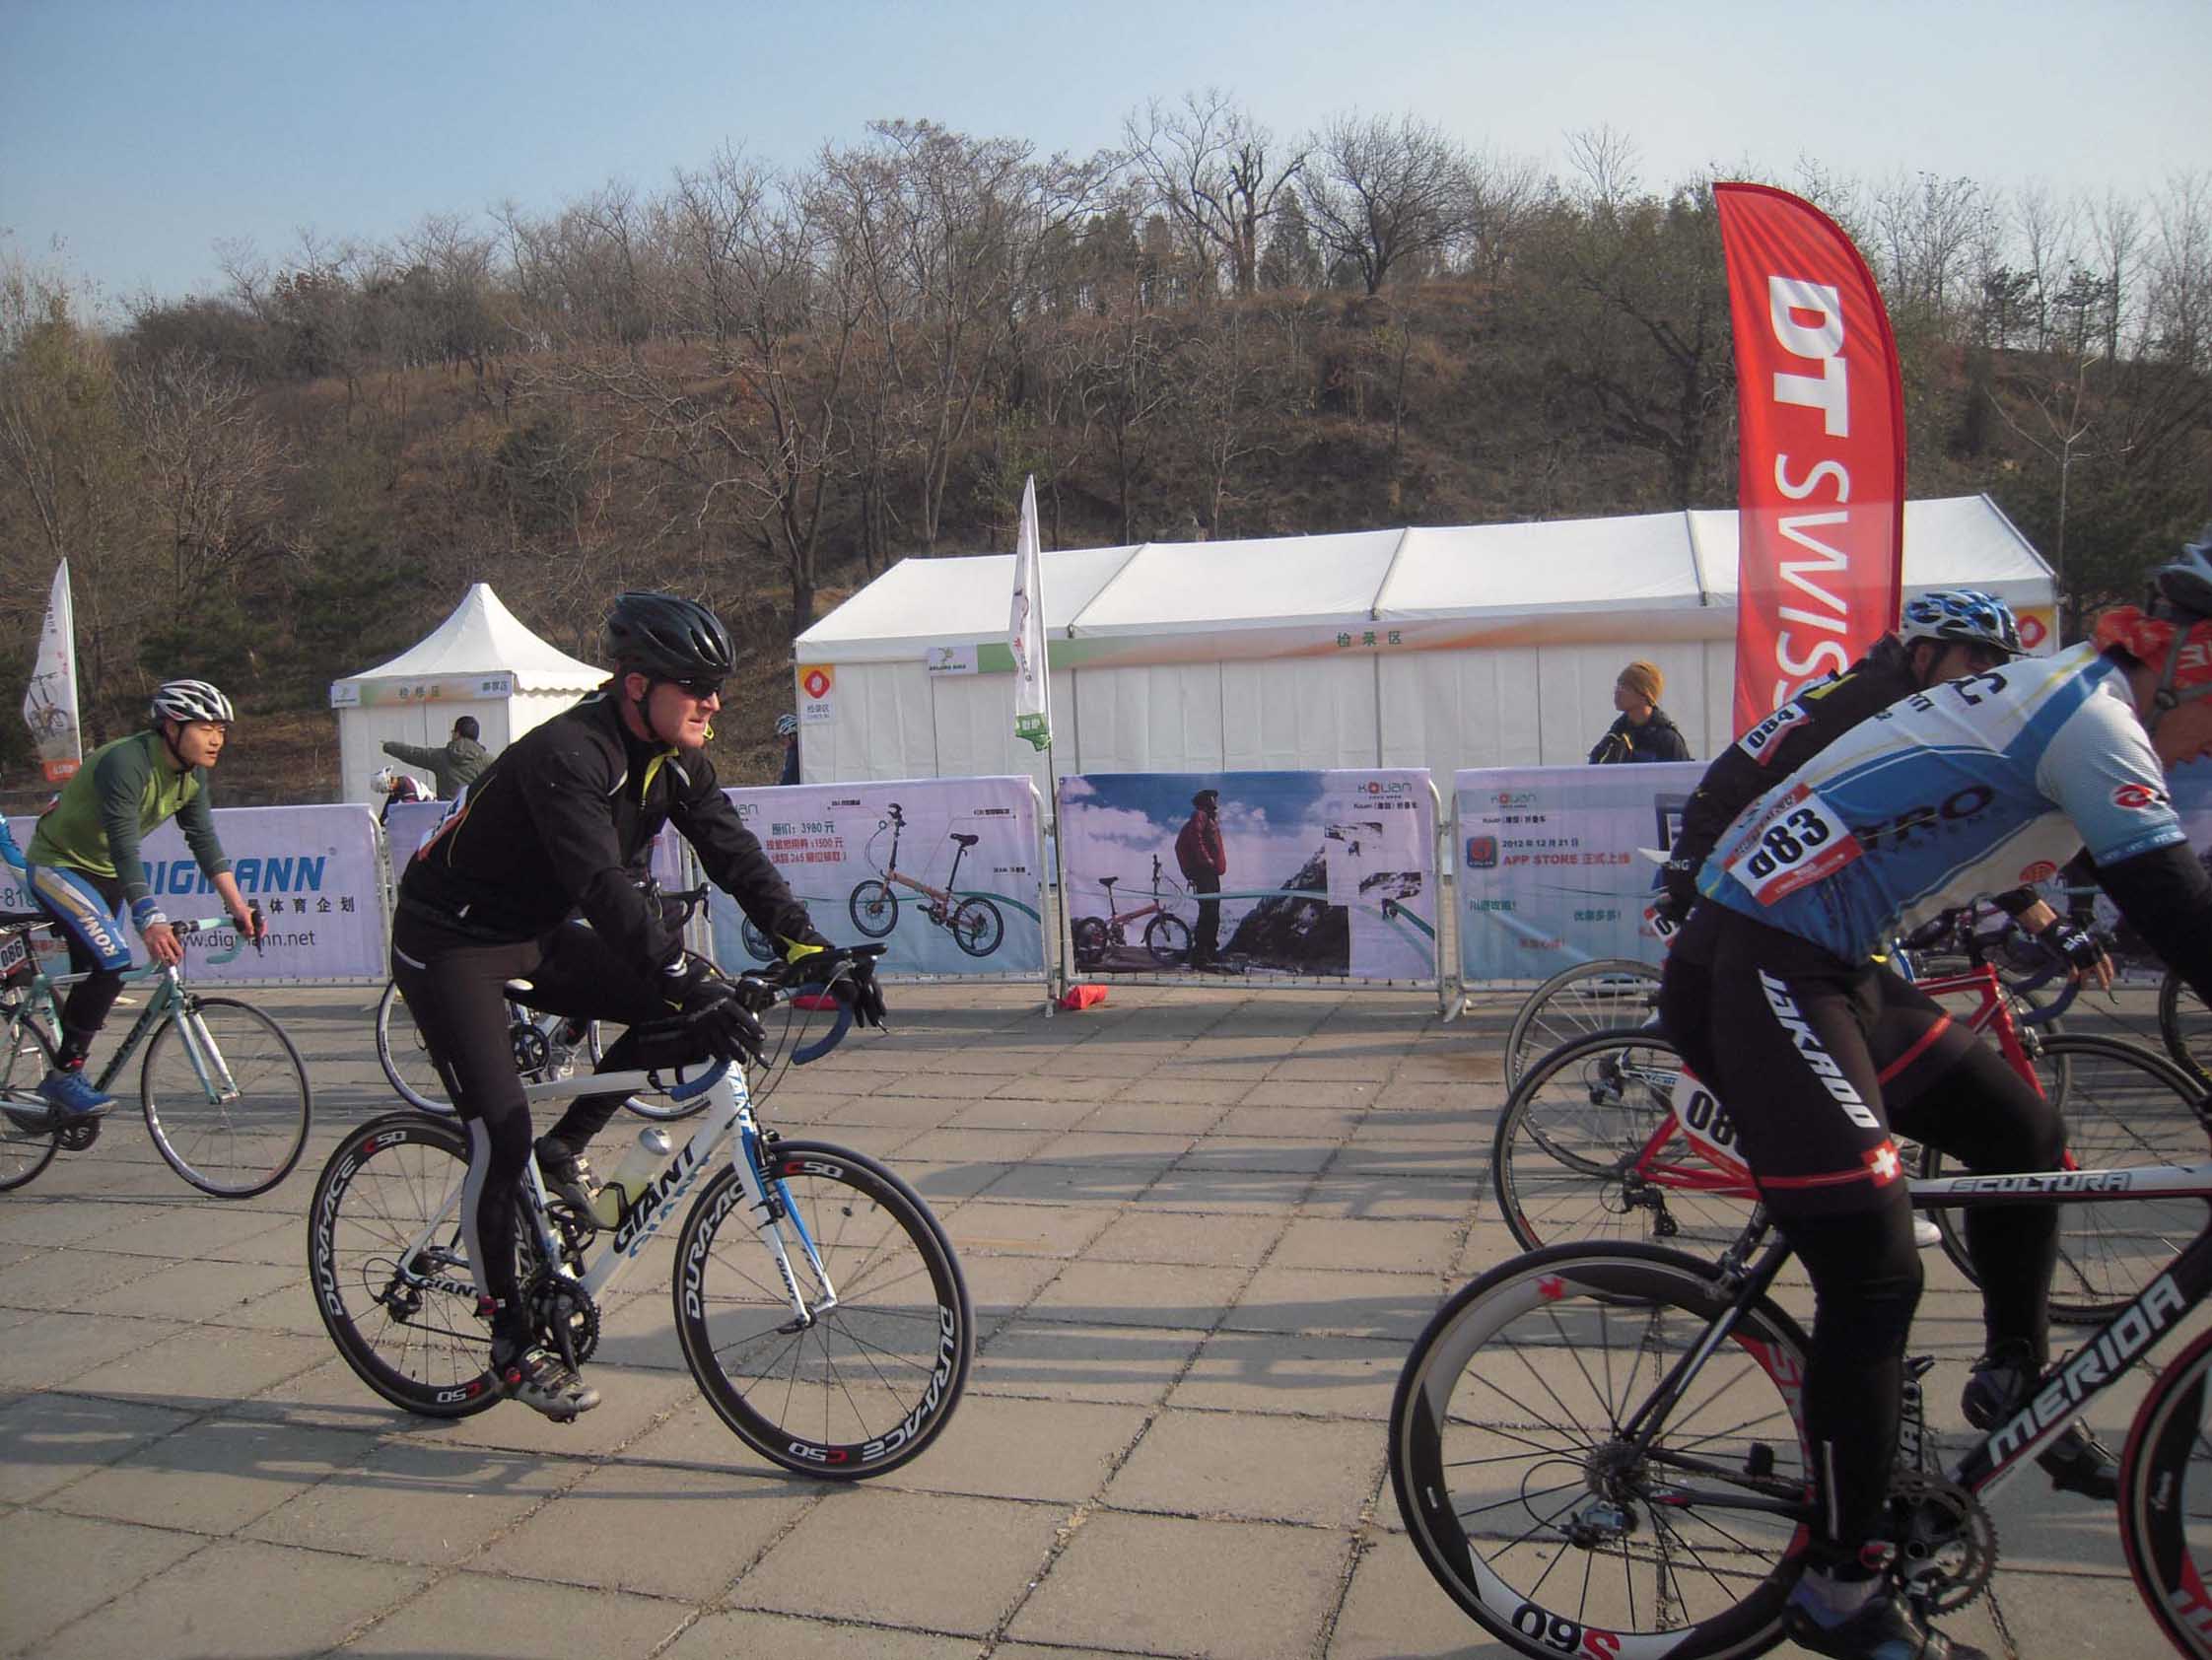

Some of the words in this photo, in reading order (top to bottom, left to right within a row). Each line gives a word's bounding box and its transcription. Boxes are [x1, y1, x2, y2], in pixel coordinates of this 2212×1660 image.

[1767, 276, 1849, 438] DT
[1773, 453, 1849, 711] SWIS
[1503, 854, 1530, 865] APP
[1534, 854, 1577, 865] STORE
[1748, 808, 1830, 879] 083
[143, 857, 326, 895] IGANN
[1, 940, 25, 968] 086
[1759, 969, 1881, 1128] JAKROO
[363, 1131, 407, 1152] C50
[1687, 1090, 1740, 1150] 08
[613, 1136, 695, 1255] GIANT
[785, 1161, 844, 1178] C50
[1949, 1171, 2132, 1193] SCULTURA
[318, 1154, 357, 1316] DURA-ACE
[437, 1382, 481, 1404] C50
[863, 1304, 954, 1462] DURA-ACE
[1987, 1272, 2187, 1468] MERIDA
[788, 1441, 849, 1464] C50
[1512, 1603, 1621, 1660] S60
